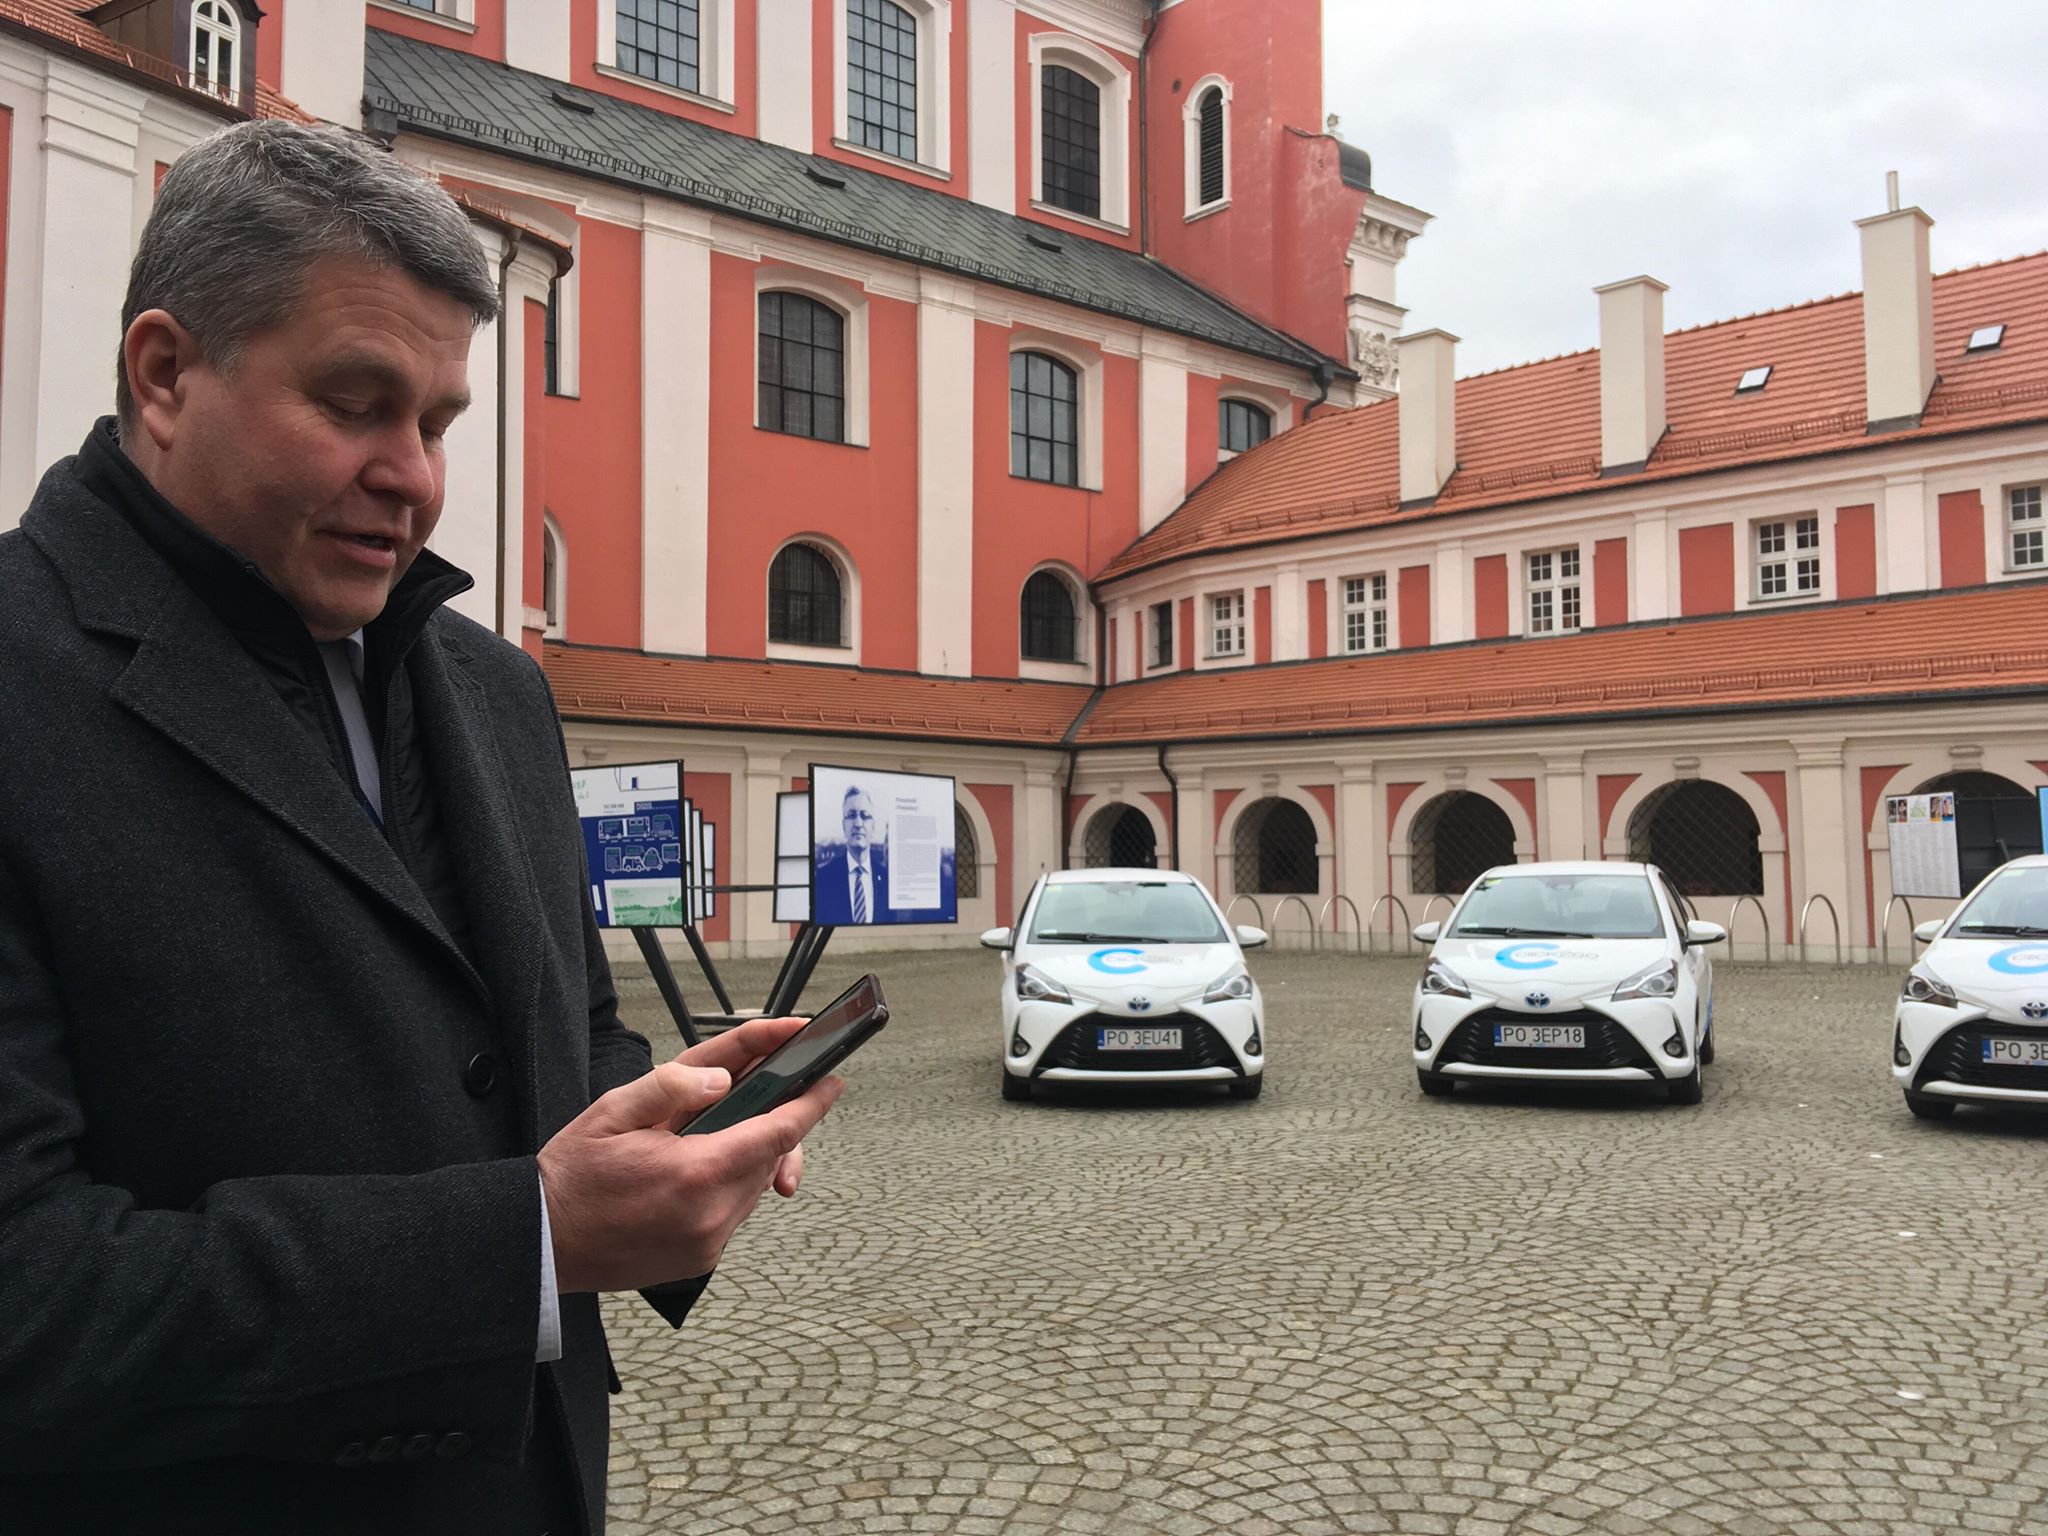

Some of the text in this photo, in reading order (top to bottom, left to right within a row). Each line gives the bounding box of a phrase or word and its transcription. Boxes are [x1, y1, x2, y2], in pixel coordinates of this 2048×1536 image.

[1106, 1030, 1178, 1045] PO 3EU41
[1503, 1027, 1582, 1043] PO 3EP18
[1994, 1041, 2022, 1059] PO
